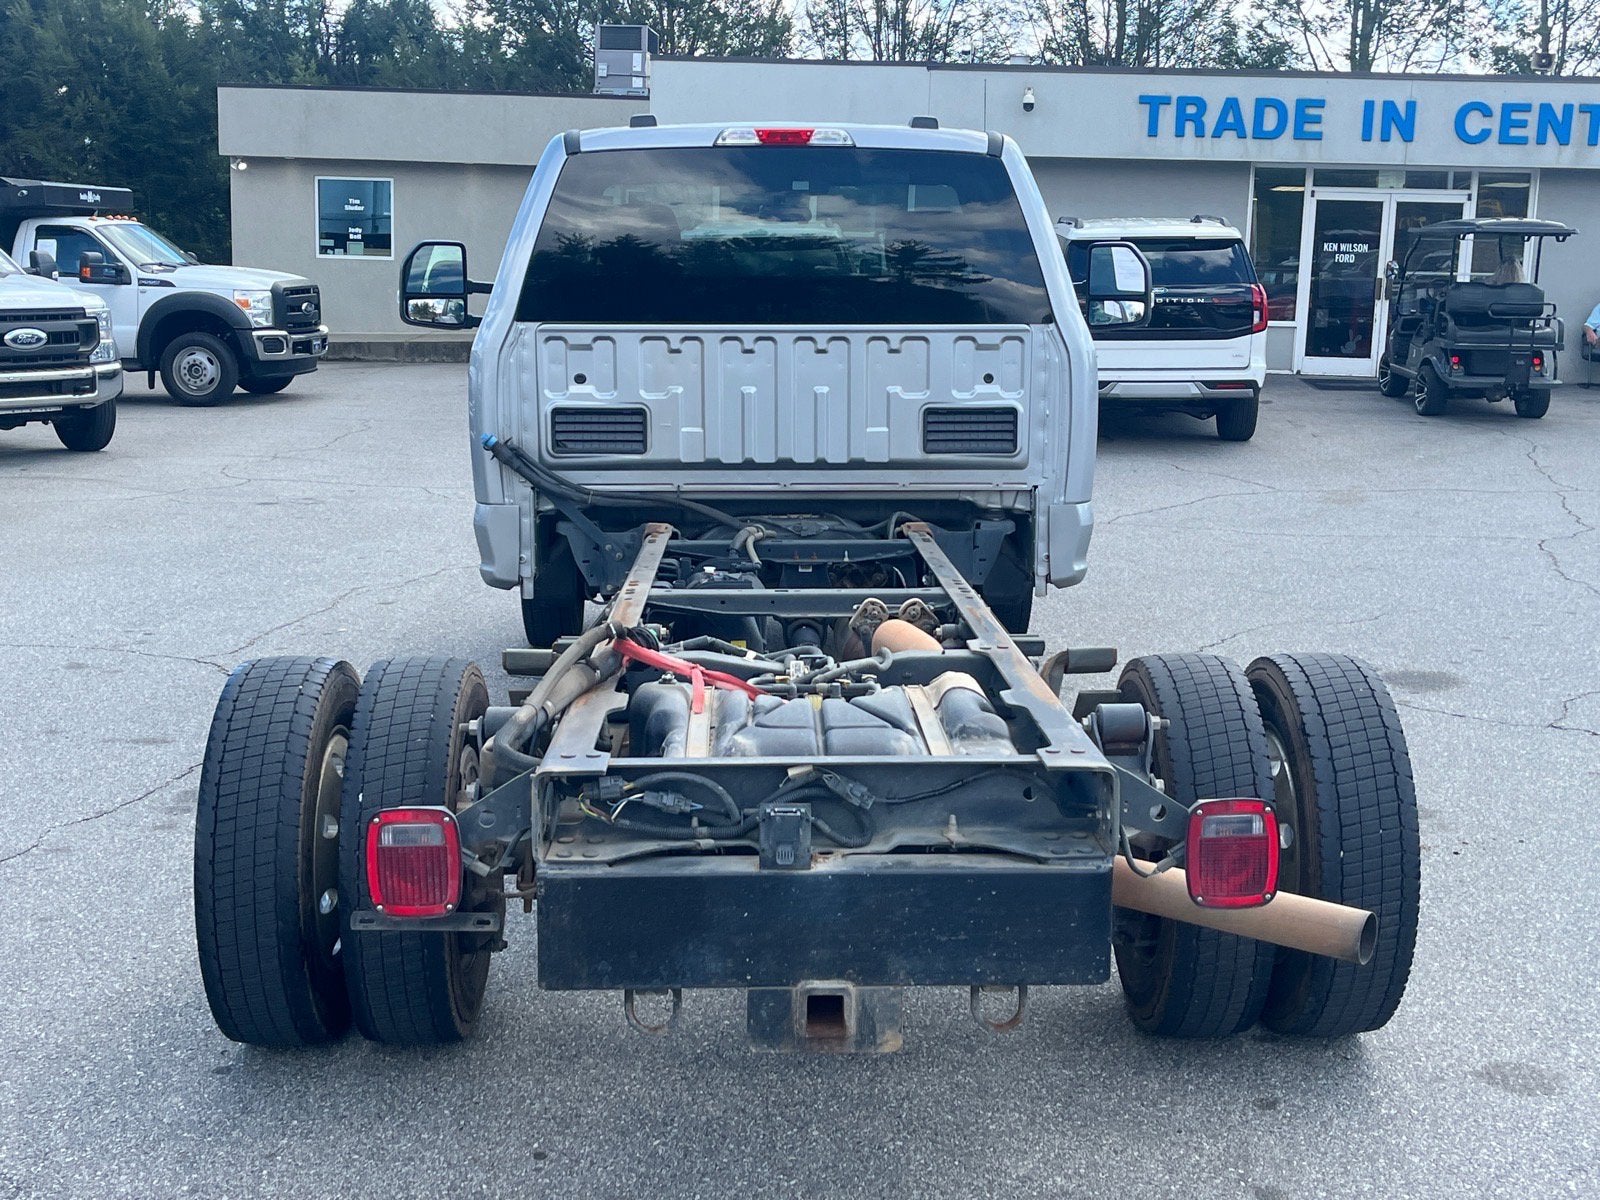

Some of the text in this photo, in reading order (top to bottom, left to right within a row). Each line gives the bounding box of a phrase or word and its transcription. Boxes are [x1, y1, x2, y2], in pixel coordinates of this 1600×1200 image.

[1138, 94, 1600, 146] TRADE IN CENT
[1323, 242, 1369, 252] KEN WILSON
[1334, 253, 1355, 263] FORD
